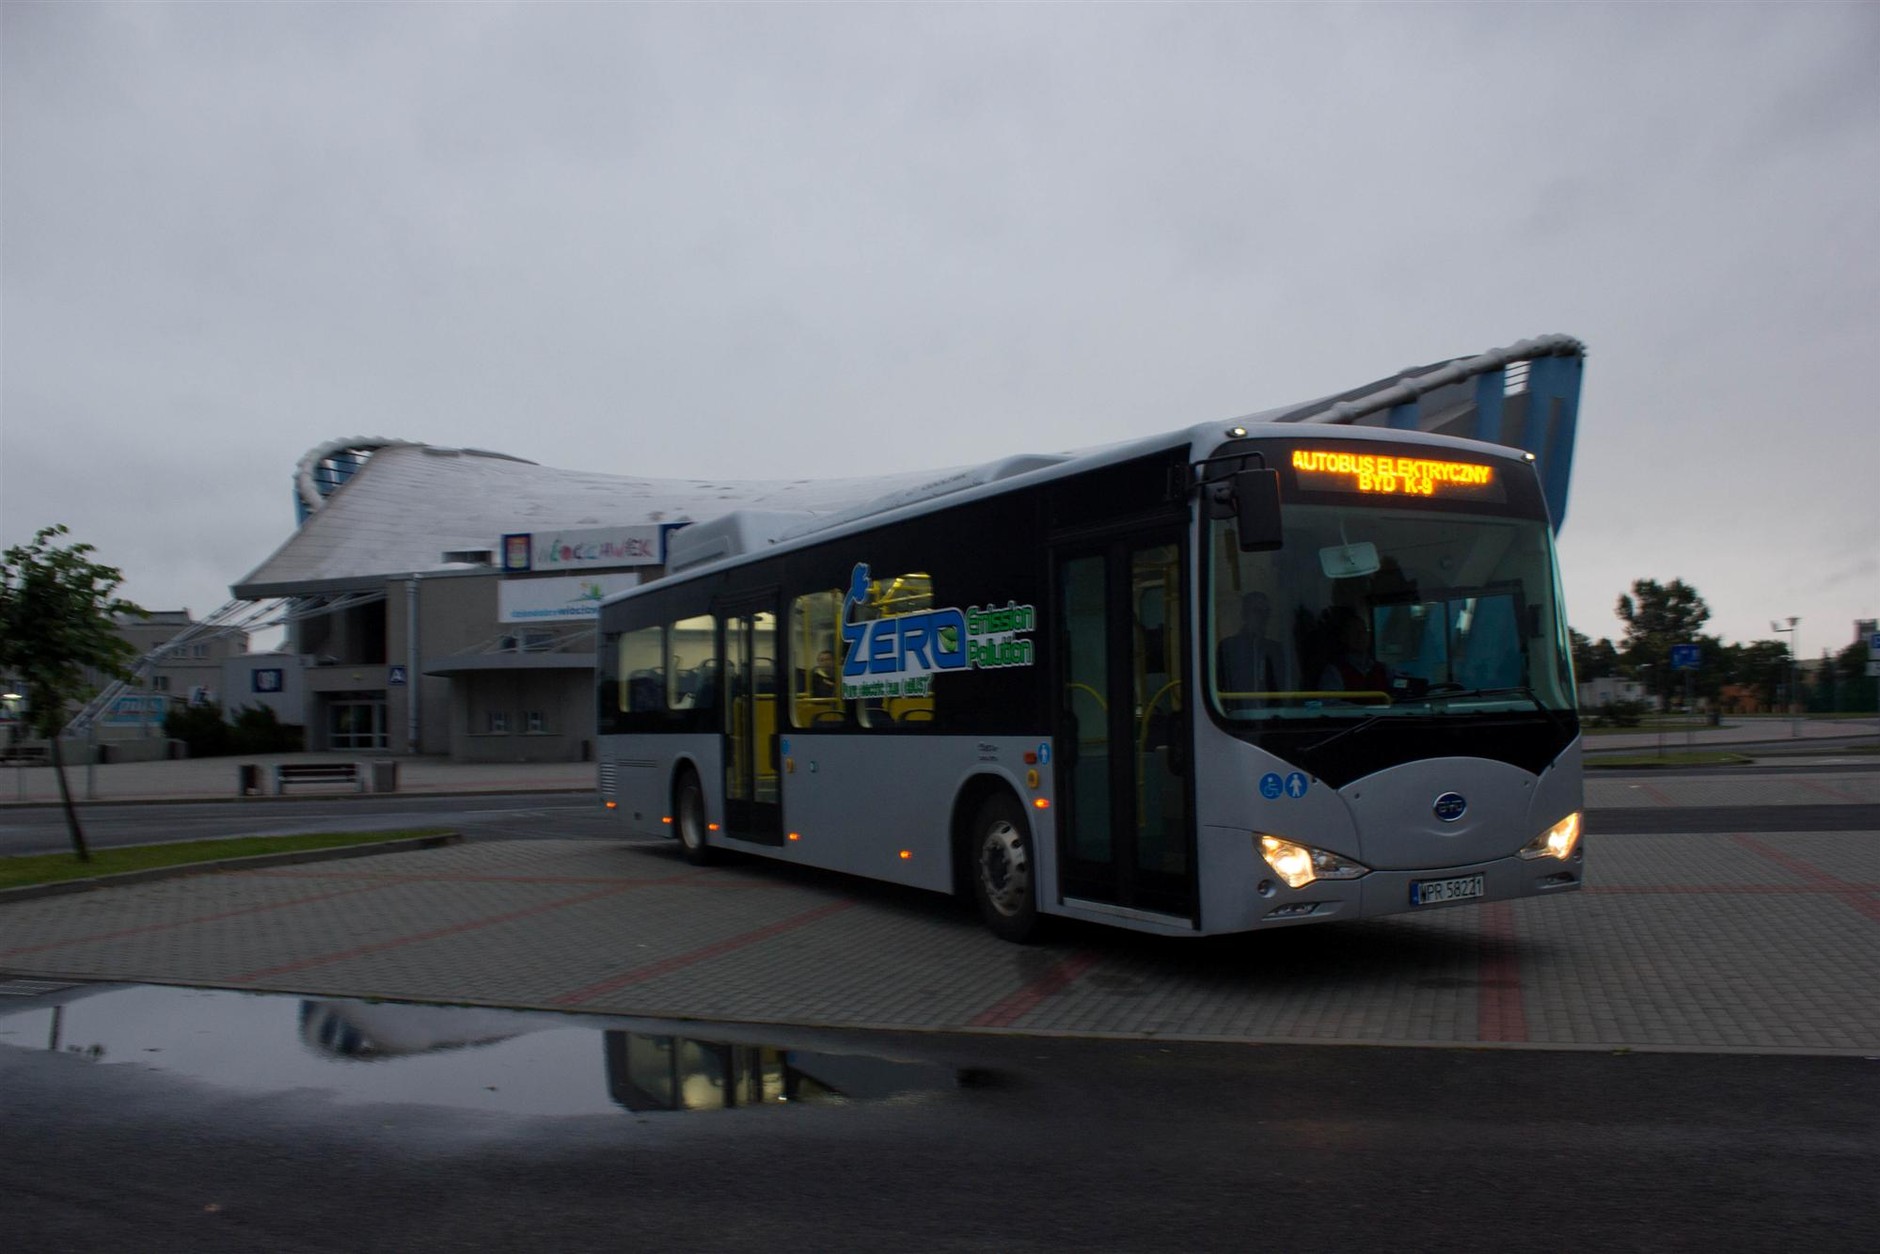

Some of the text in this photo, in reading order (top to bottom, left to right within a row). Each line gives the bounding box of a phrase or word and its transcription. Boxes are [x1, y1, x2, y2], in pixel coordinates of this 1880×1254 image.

[1292, 450, 1488, 484] AUTOBUS ELEKTRYCZNY
[1359, 473, 1433, 495] BYD K-9
[966, 602, 1036, 635] Emission
[842, 609, 966, 676] ZERO
[1420, 882, 1442, 902] WPR
